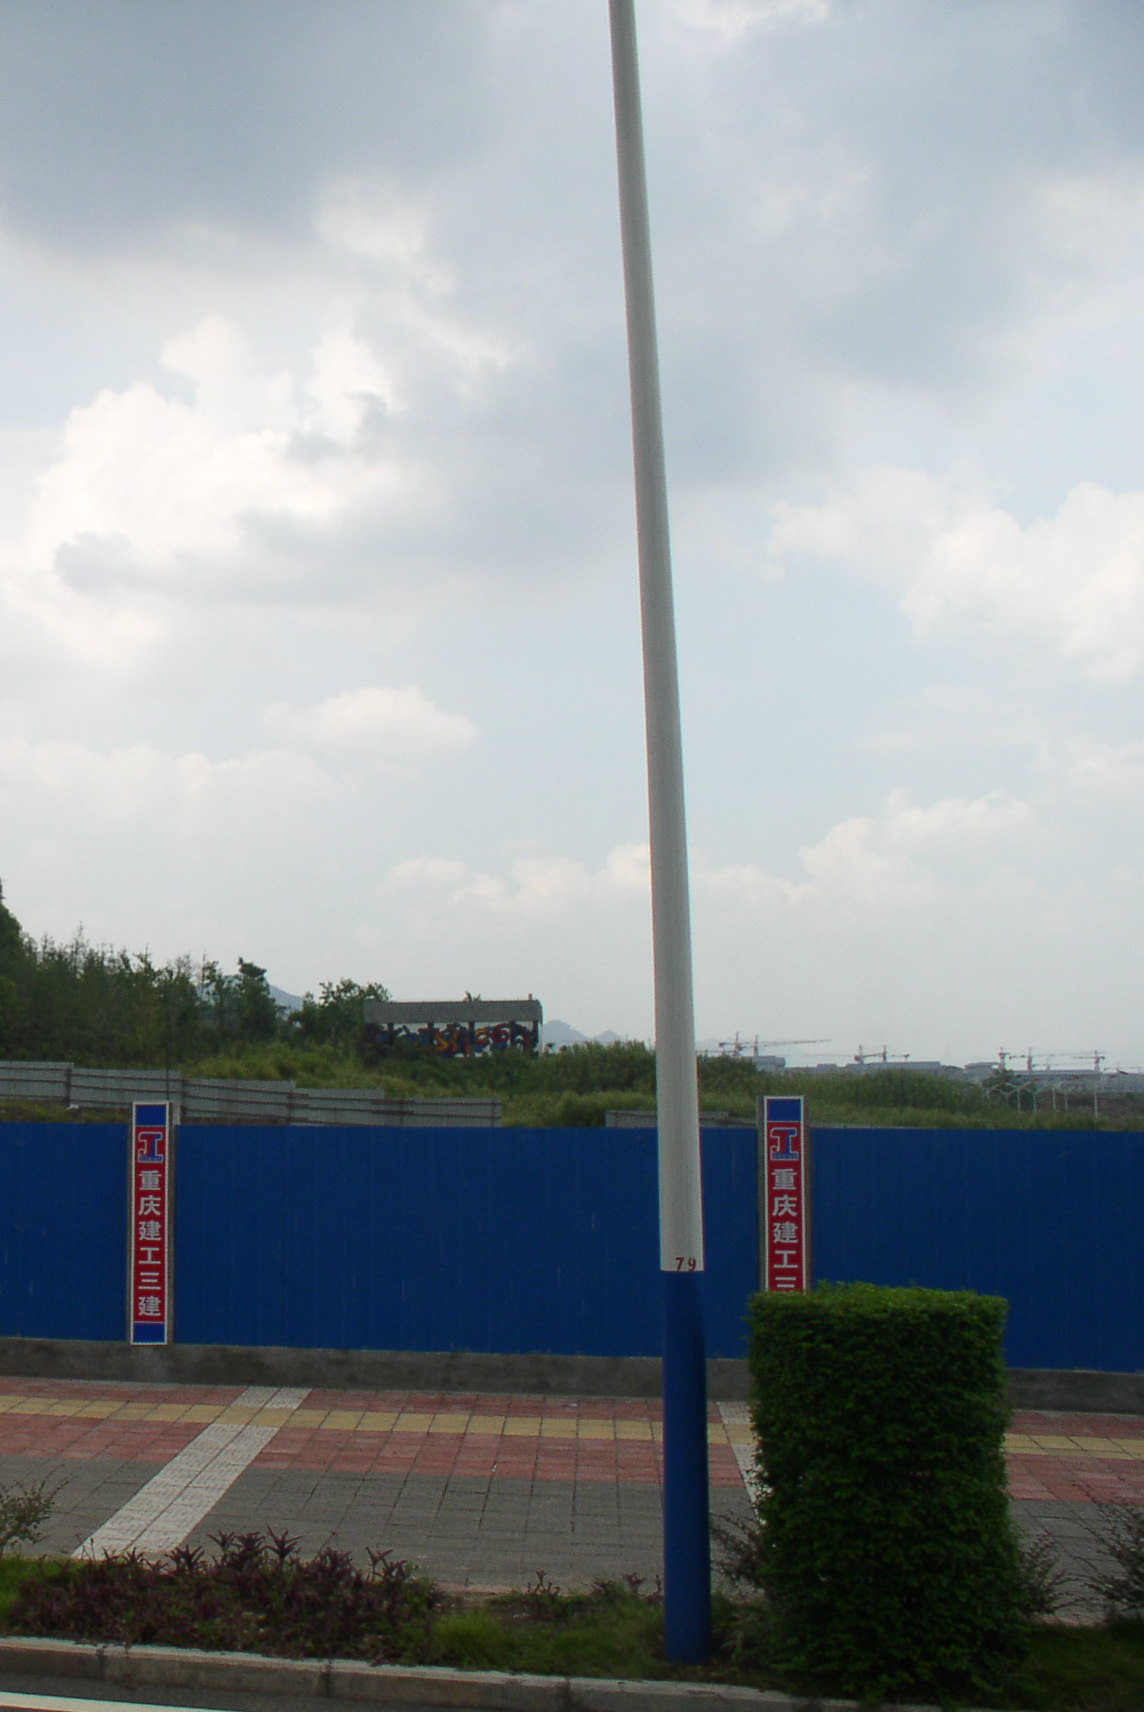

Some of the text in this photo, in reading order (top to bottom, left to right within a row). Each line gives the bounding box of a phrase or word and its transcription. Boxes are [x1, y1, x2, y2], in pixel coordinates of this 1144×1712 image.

[138, 1170, 162, 1316] 重庆建工三建
[675, 1256, 696, 1271] 79
